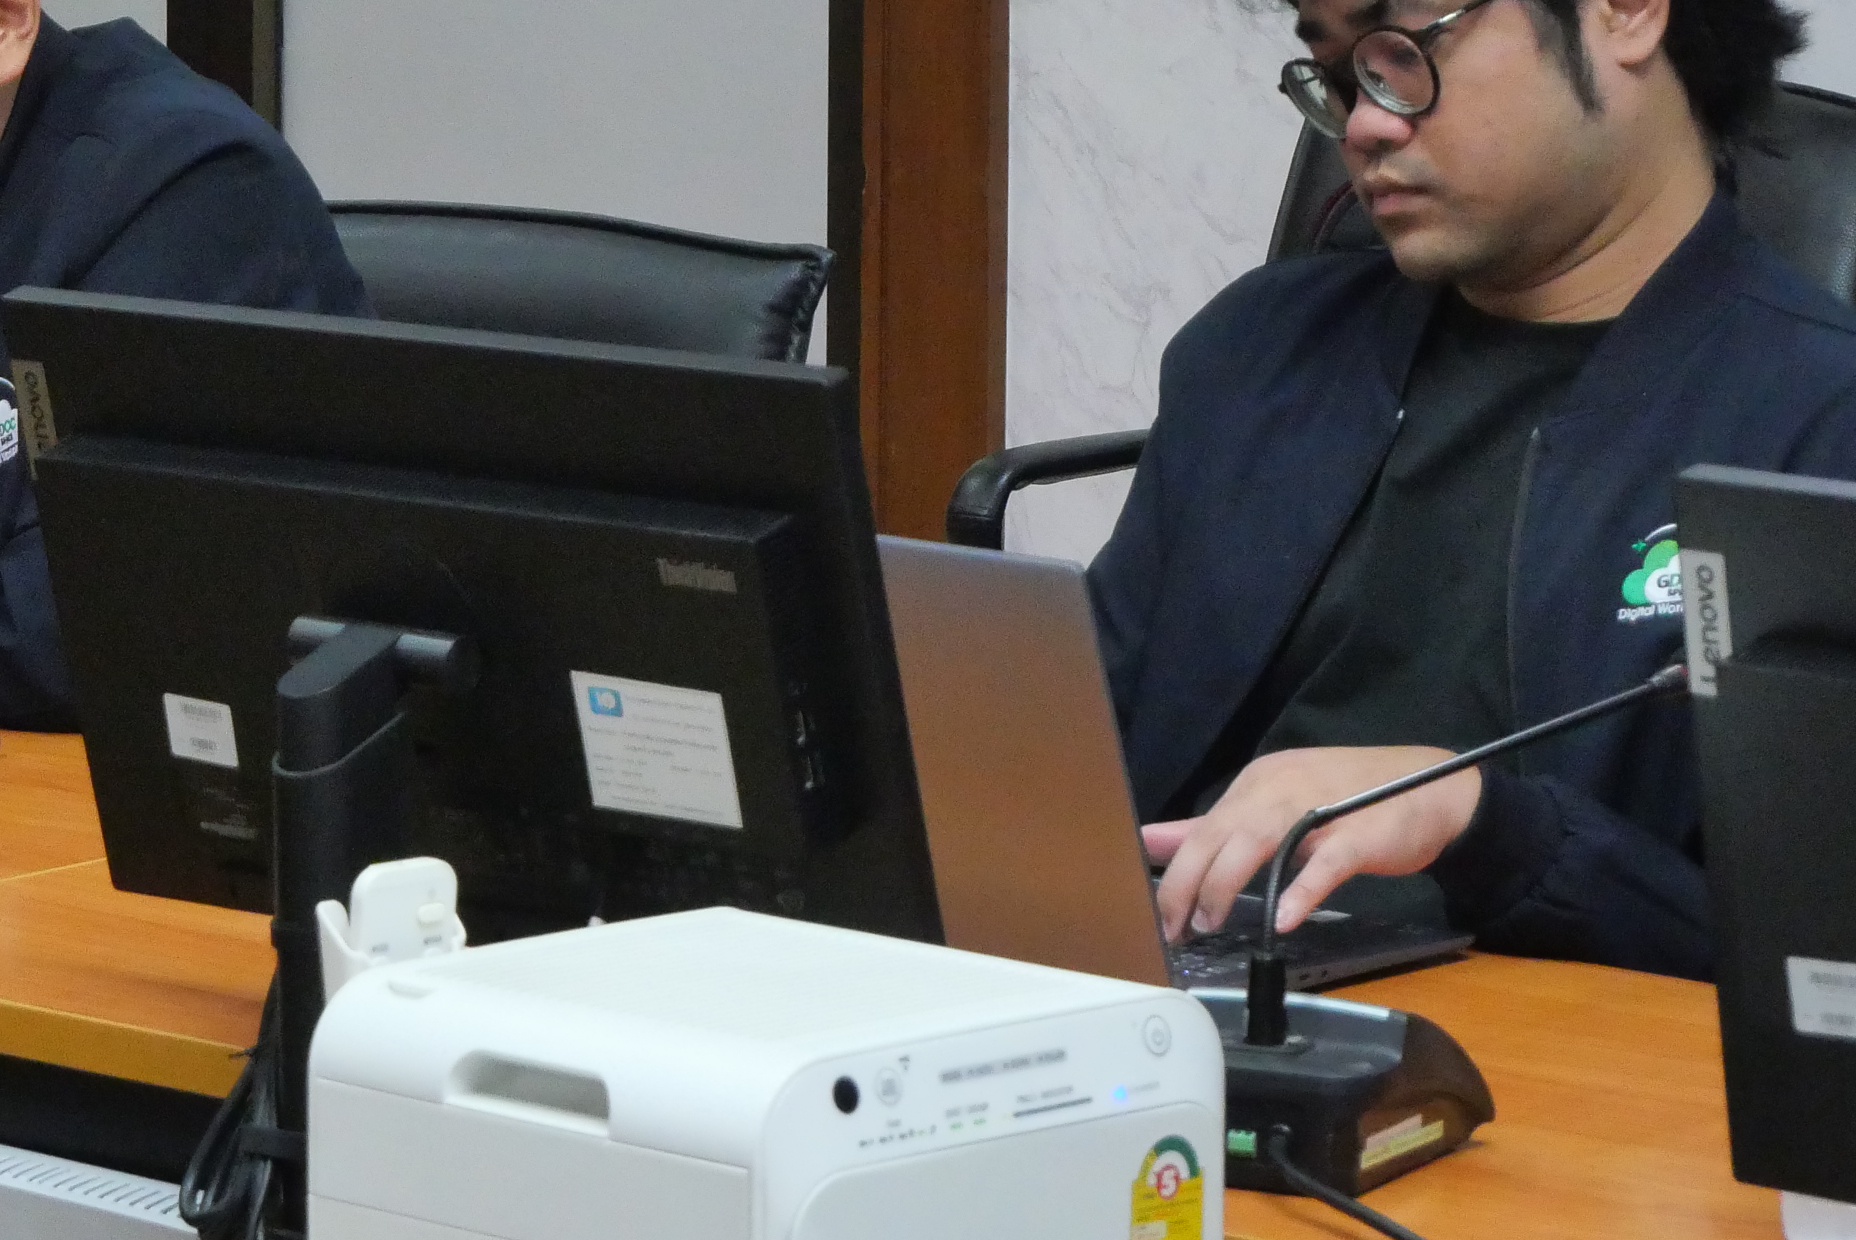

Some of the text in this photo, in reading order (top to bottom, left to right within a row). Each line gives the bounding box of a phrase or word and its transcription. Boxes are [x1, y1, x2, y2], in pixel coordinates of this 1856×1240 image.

[1657, 574, 1683, 588] GD
[1617, 602, 1684, 621] Digital Wor
